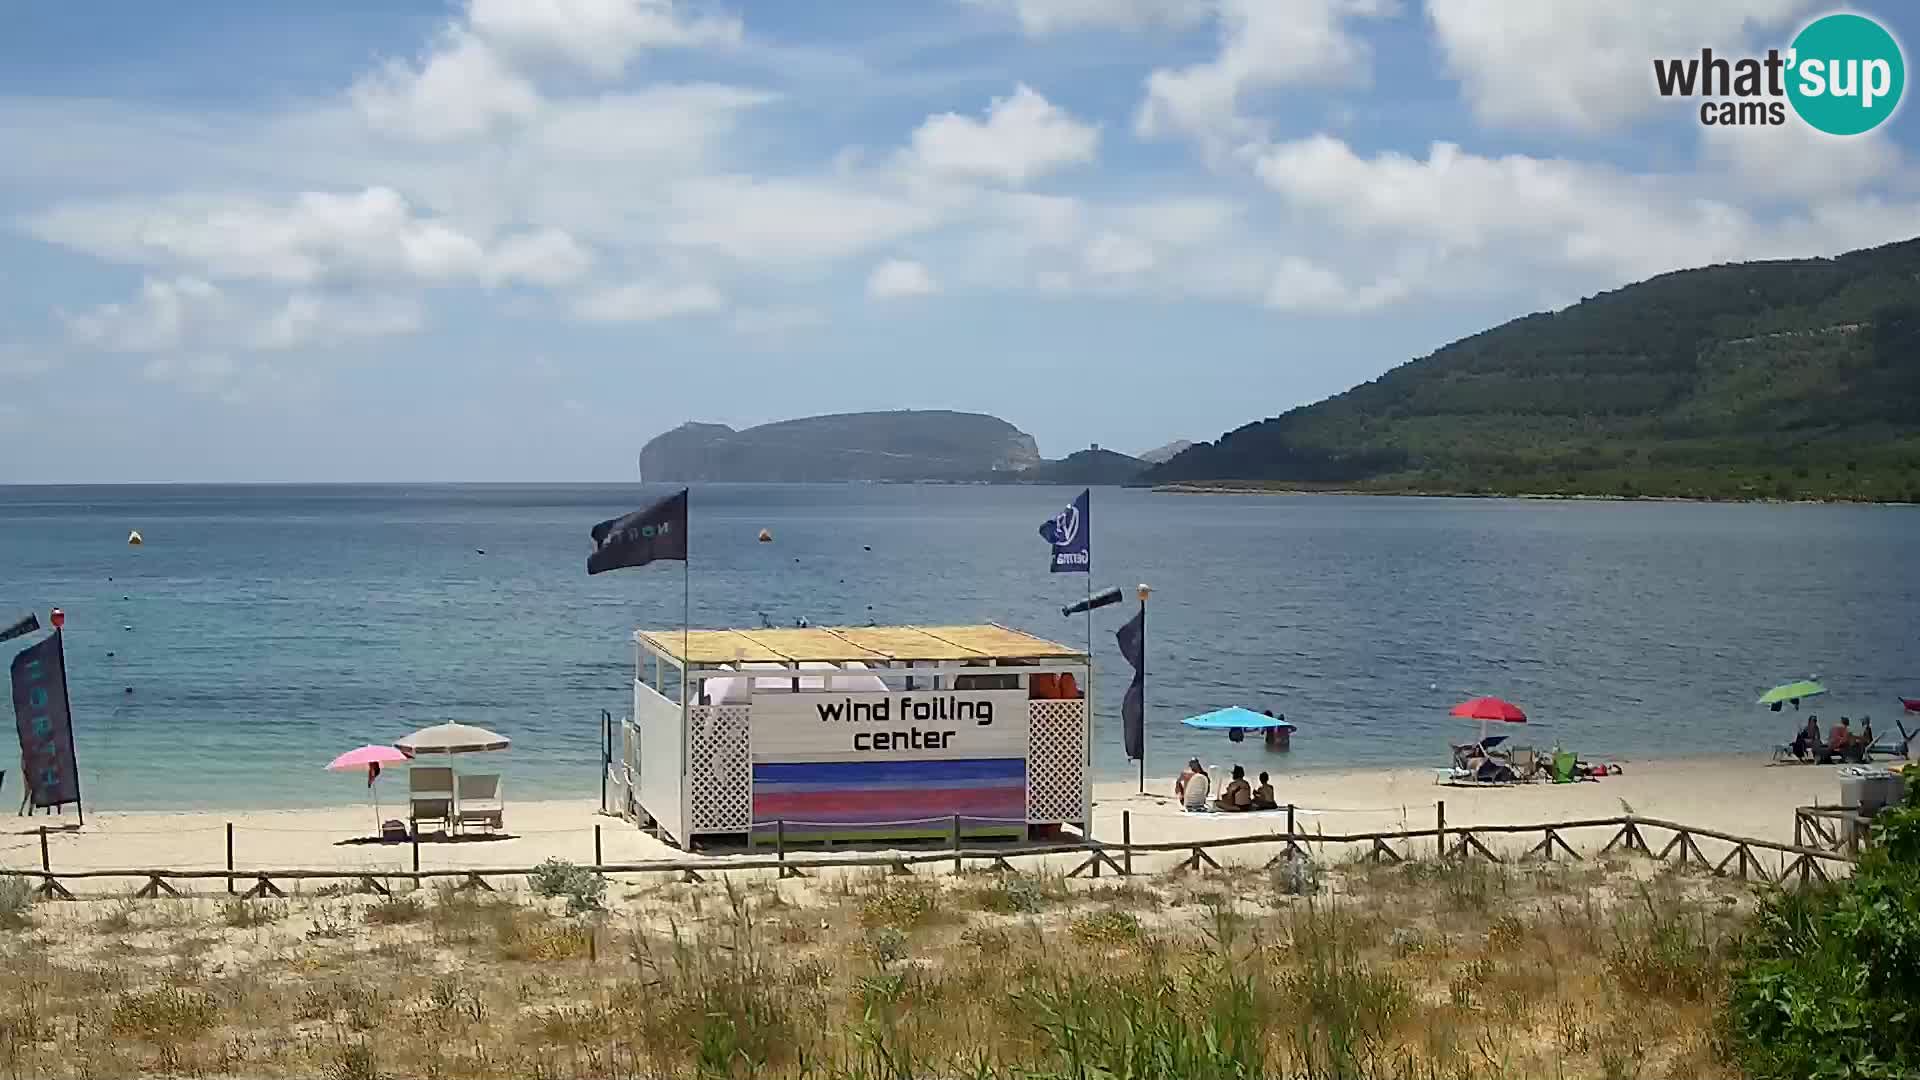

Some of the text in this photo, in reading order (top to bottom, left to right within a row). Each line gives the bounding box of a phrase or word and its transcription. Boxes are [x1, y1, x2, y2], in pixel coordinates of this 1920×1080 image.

[817, 696, 993, 725] wind foiling
[854, 727, 956, 750] center
